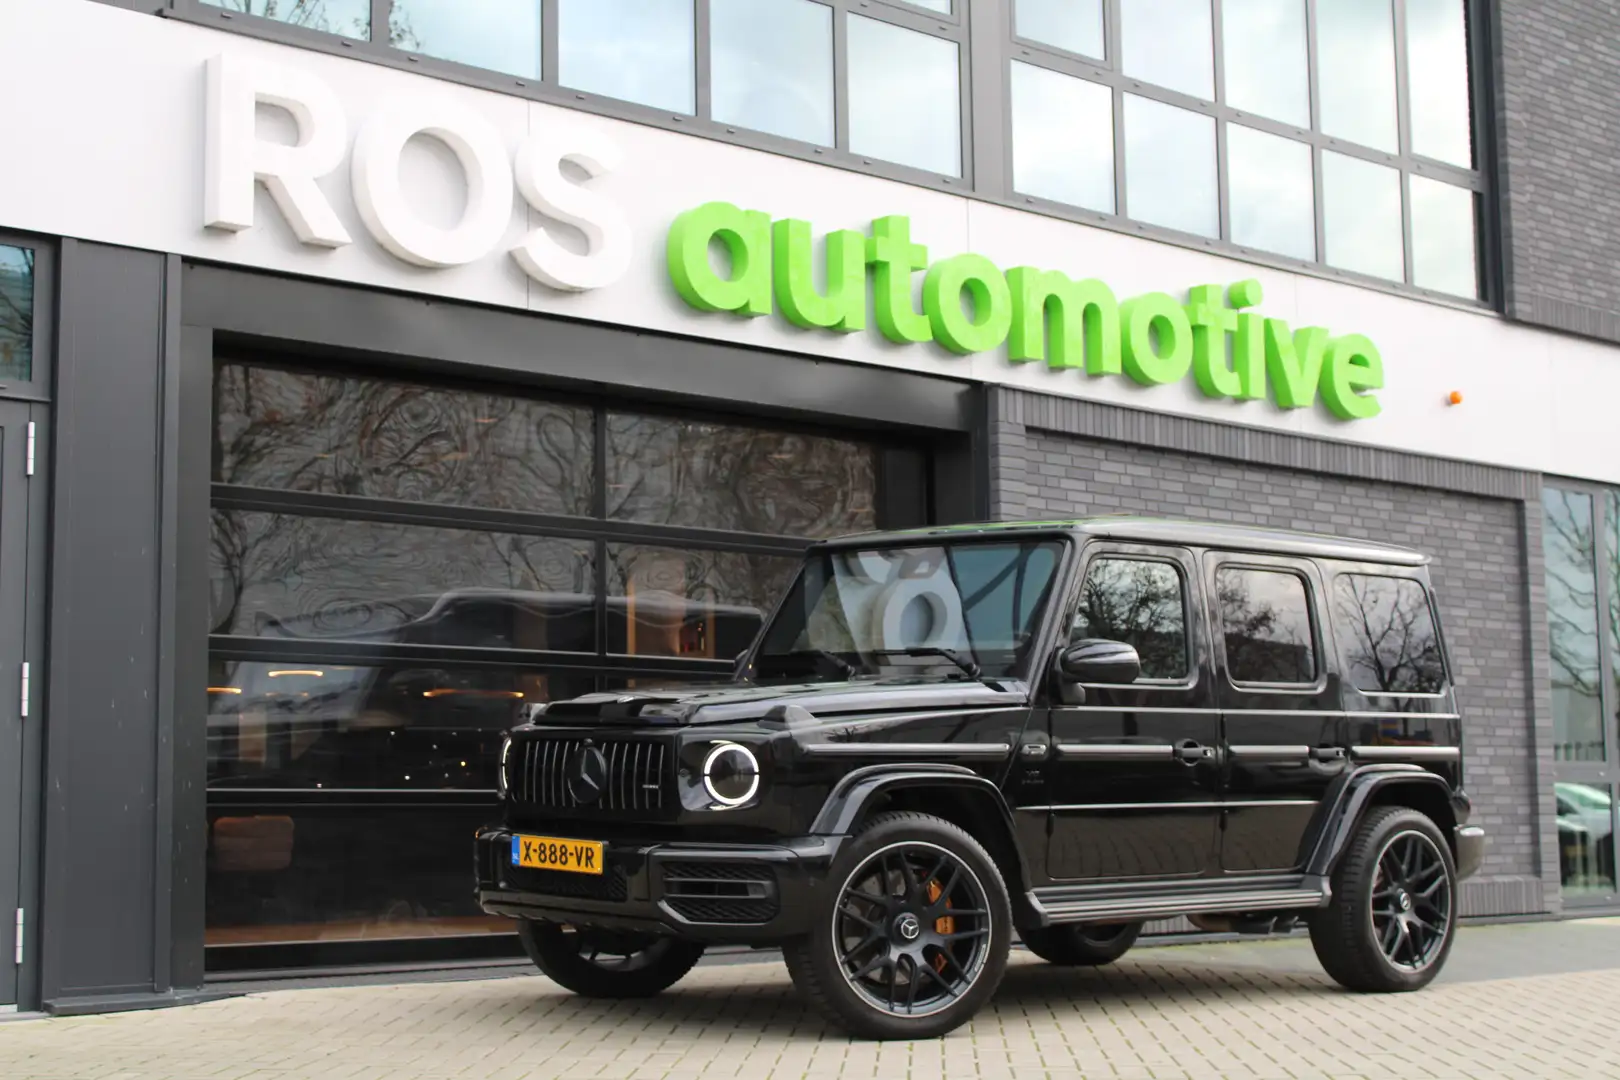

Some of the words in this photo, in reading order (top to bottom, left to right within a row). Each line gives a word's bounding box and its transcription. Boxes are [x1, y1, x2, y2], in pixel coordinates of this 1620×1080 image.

[204, 51, 632, 292] ROS
[666, 202, 1384, 420] automotive
[523, 840, 595, 869] X-888-VR
